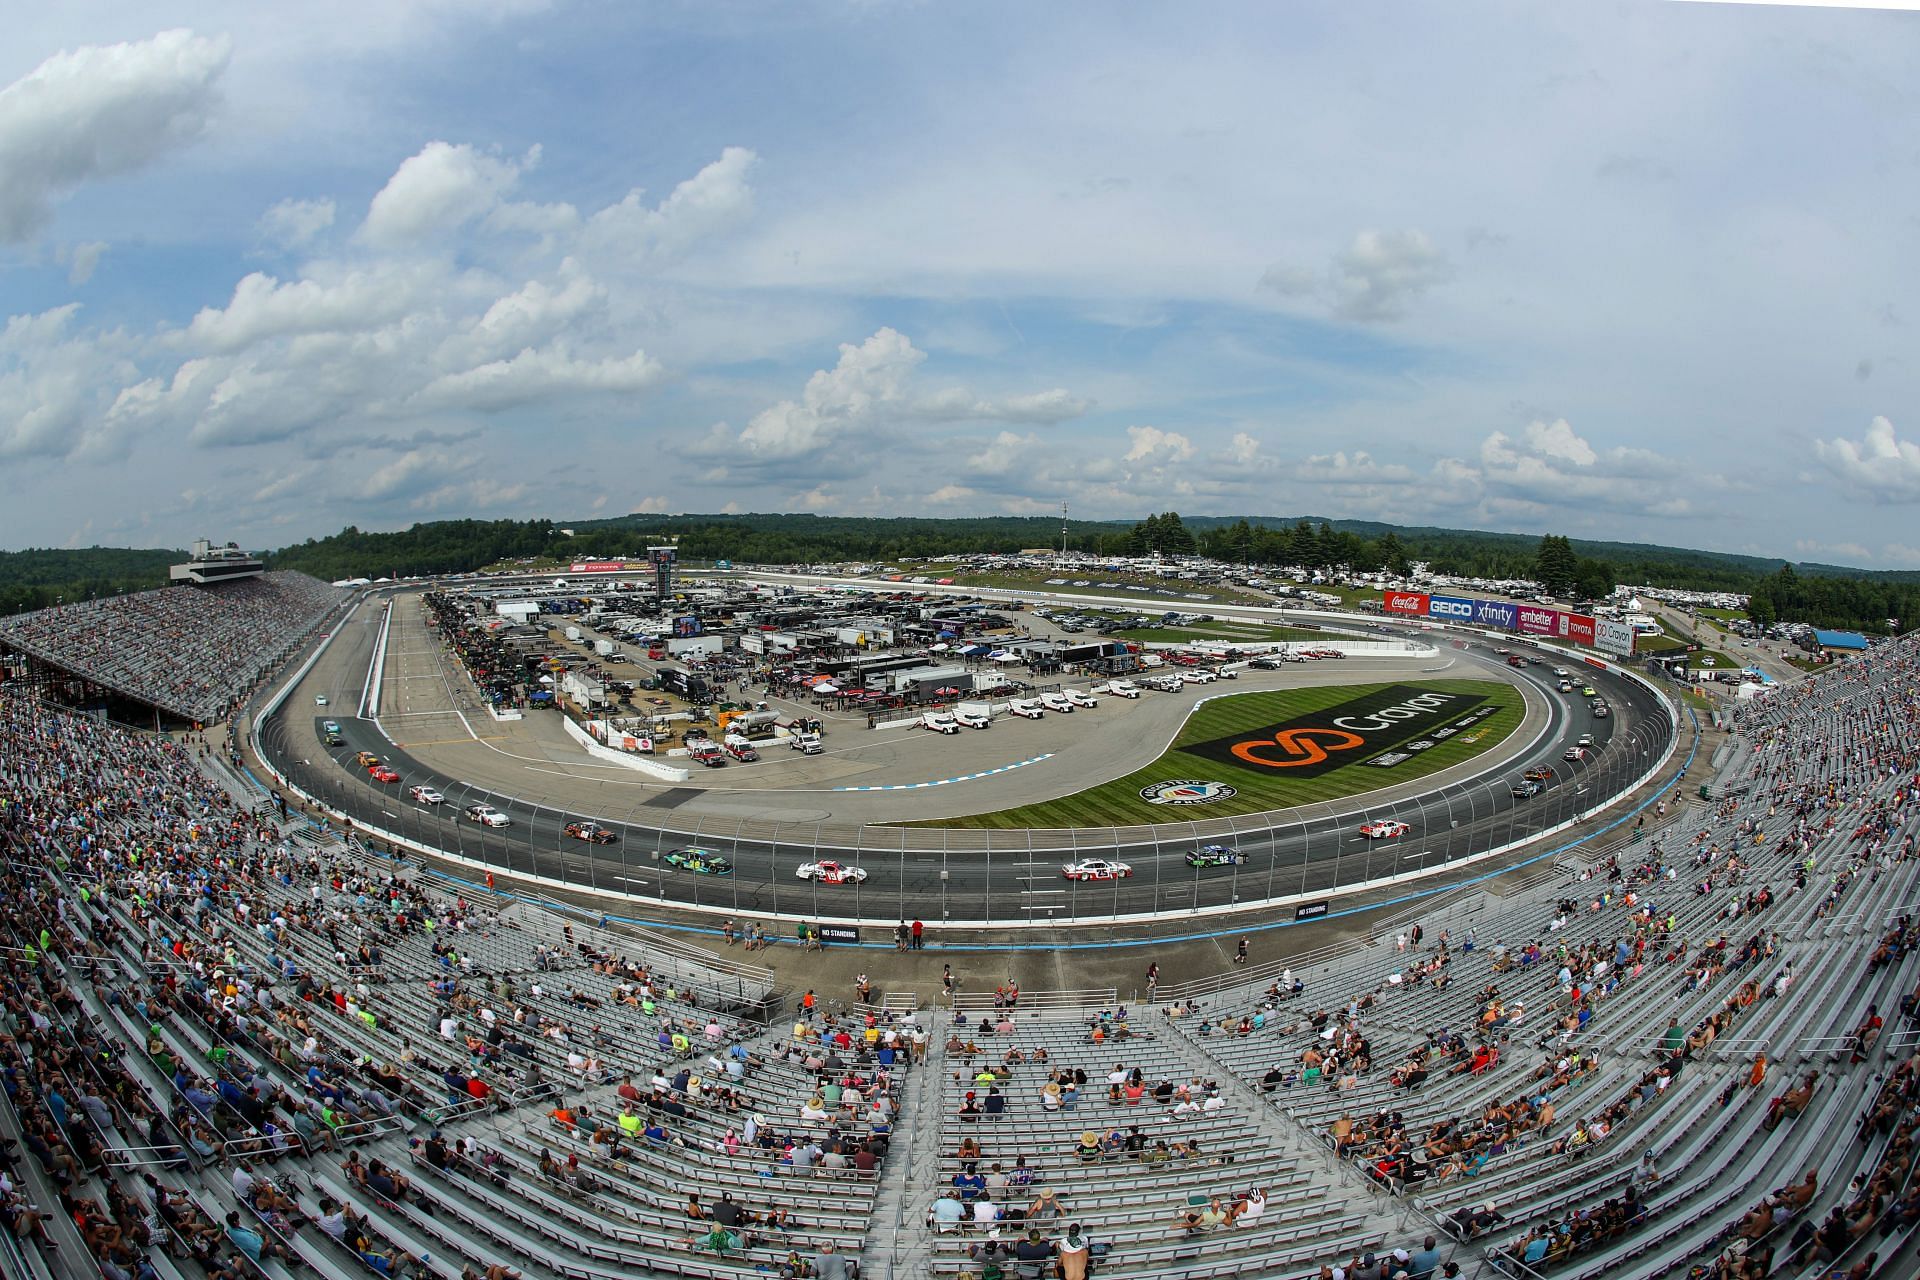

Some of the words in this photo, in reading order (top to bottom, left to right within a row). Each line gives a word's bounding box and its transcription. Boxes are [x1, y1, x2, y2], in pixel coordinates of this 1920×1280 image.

[1430, 600, 1472, 617] GEICO
[1478, 603, 1512, 625] xfinity
[1520, 610, 1552, 626] ambetter
[1570, 622, 1592, 636] TOYOTA
[1608, 625, 1630, 643] Crayon
[1333, 693, 1456, 731] Crayon
[1219, 855, 1229, 864] 92
[826, 872, 837, 880] 19
[1096, 869, 1108, 877] 25
[830, 929, 856, 938] STANDING
